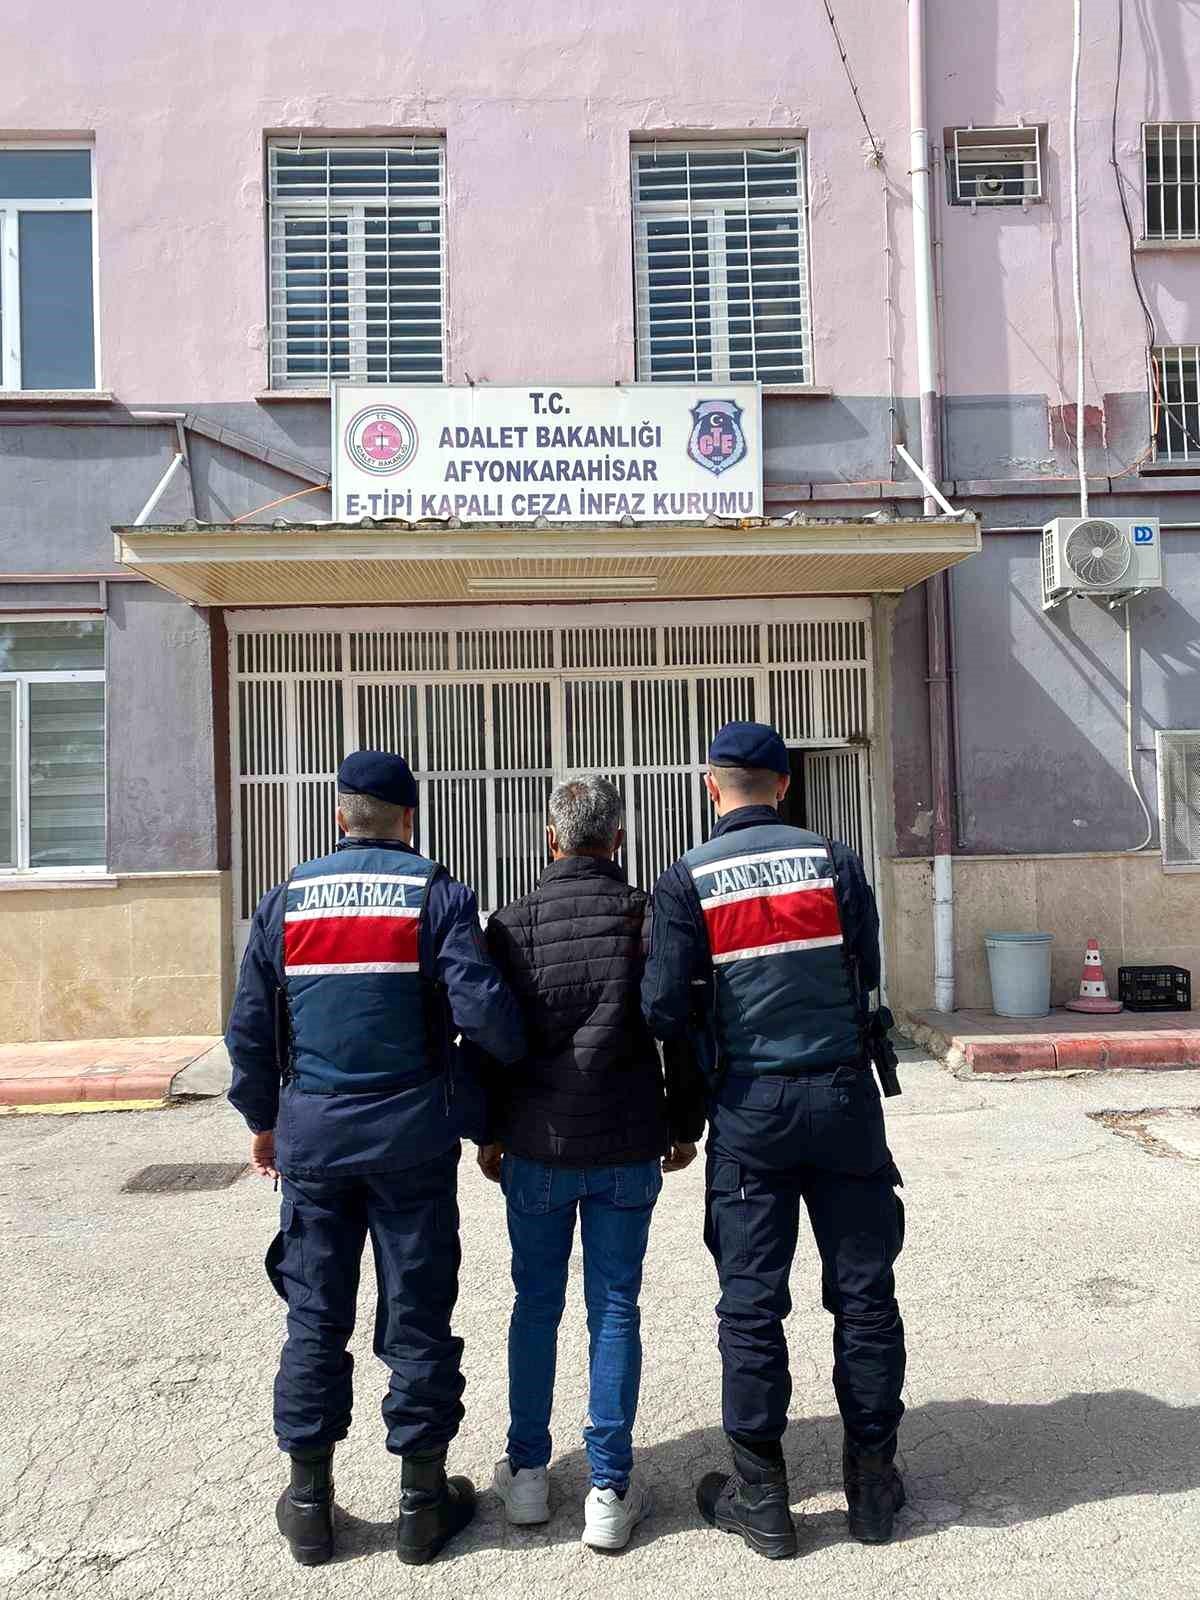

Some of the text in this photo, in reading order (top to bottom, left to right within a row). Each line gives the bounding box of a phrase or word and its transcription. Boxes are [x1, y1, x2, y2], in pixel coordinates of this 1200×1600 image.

[529, 392, 570, 414] T.C.
[438, 420, 662, 448] ADALET BAKANLIĞI
[444, 454, 658, 482] AFYONKARAHİSAR
[346, 488, 753, 516] E-TİPİ KAPALI CEZA İNFAZ KURUMU
[710, 857, 819, 896] JANDARMA
[297, 883, 407, 911] JANDARMA
